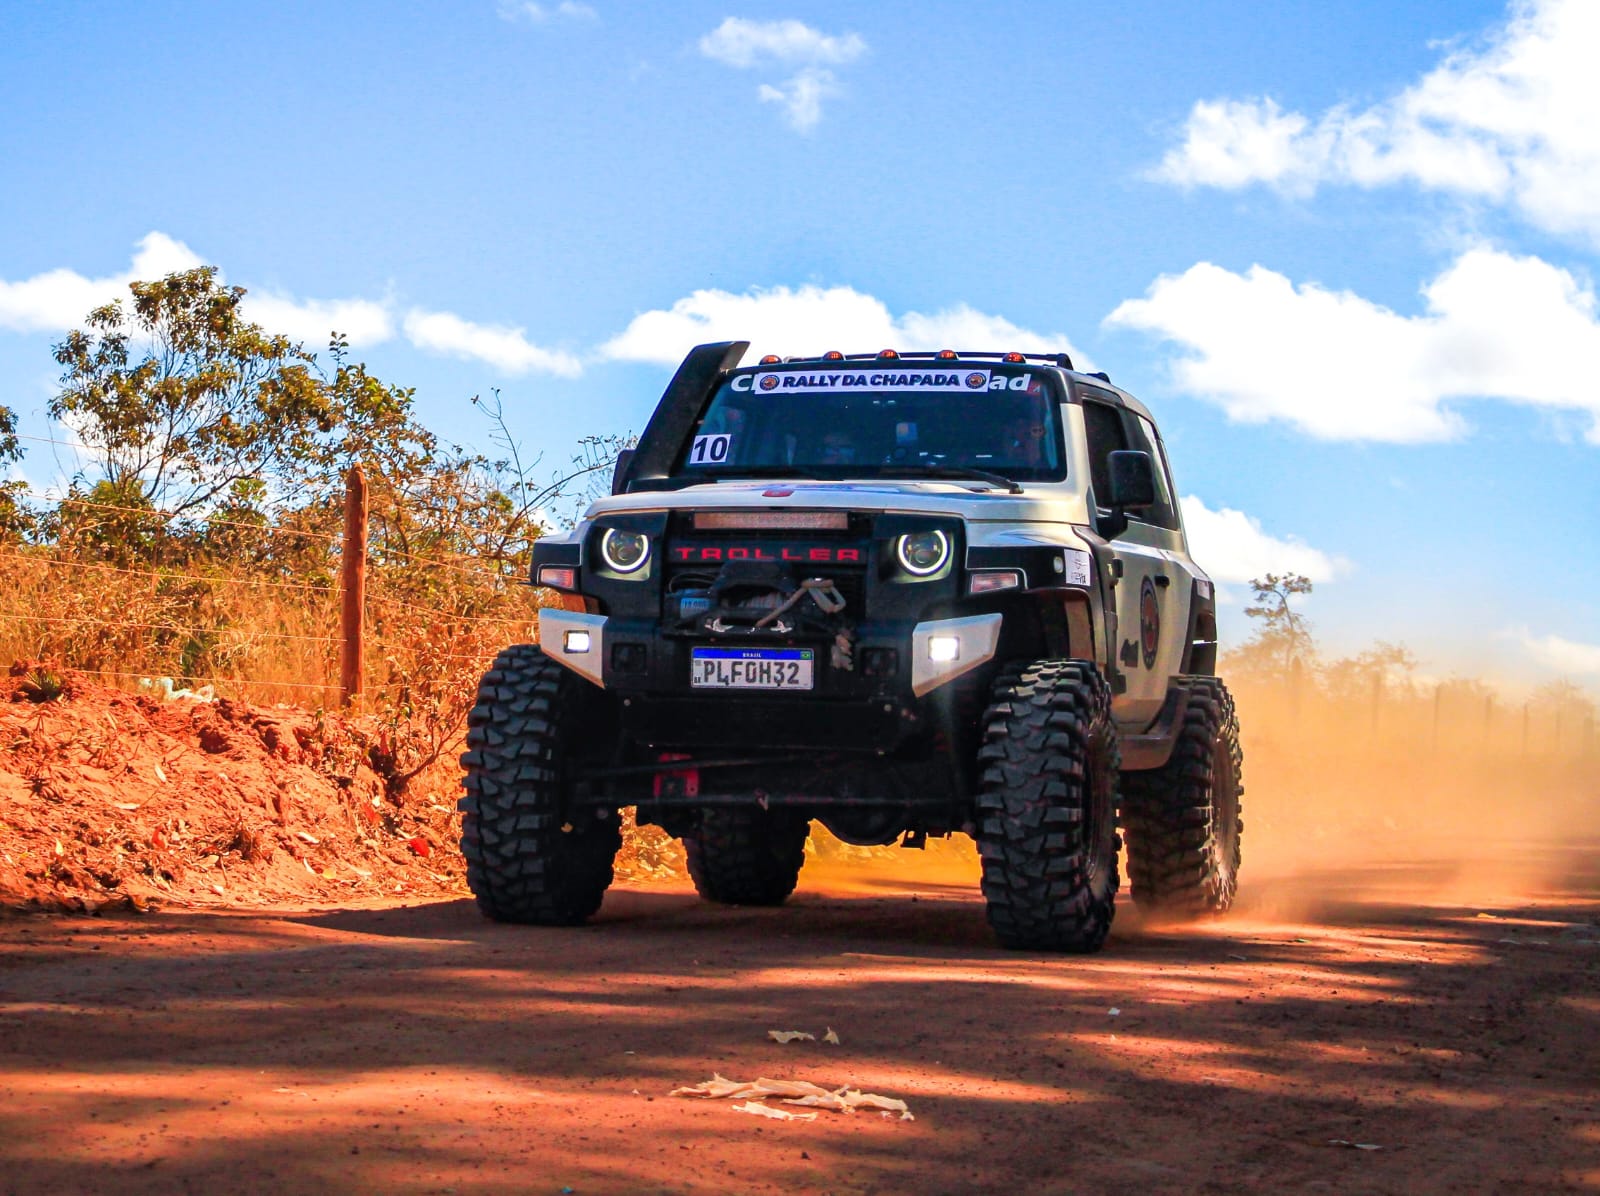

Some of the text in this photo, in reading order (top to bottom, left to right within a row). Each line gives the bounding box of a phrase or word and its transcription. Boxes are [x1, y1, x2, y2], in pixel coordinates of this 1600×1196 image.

[782, 374, 842, 388] RALLY
[842, 374, 868, 387] DA
[869, 373, 960, 387] CHAPADA
[694, 436, 728, 461] 10
[675, 547, 859, 561] TROLLER
